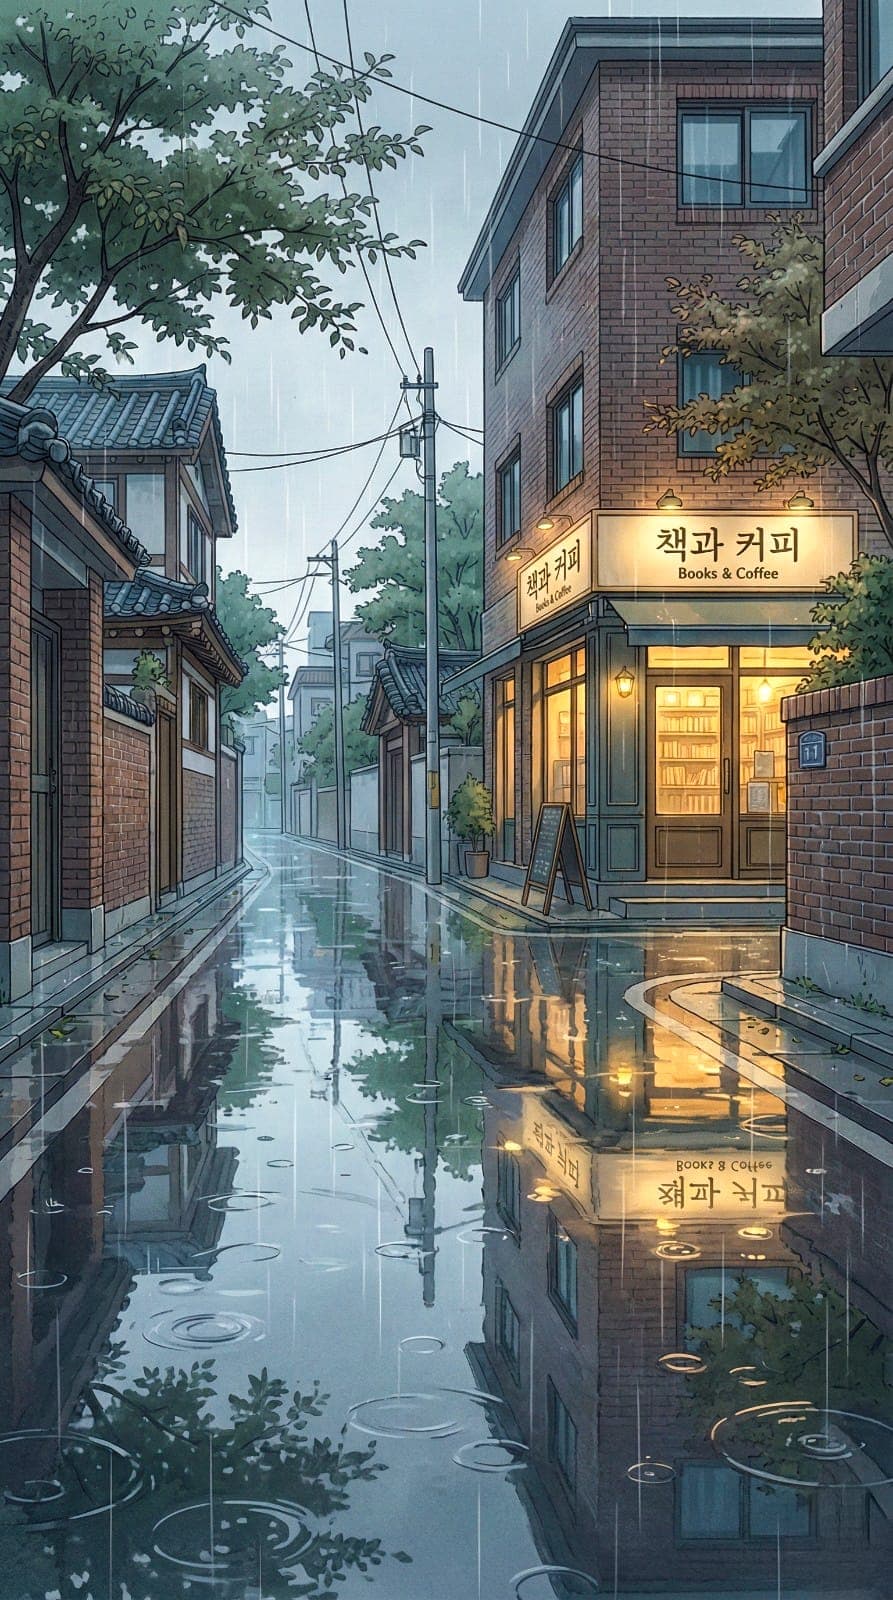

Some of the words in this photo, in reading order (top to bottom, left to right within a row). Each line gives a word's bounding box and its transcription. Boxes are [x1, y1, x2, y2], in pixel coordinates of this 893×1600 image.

[656, 526, 725, 563] 책과
[736, 526, 798, 563] 커피
[527, 561, 551, 600] 책과
[555, 538, 580, 581] 커피
[678, 567, 718, 579] Books
[722, 567, 732, 579] &
[736, 567, 779, 579] Coffee
[536, 598, 550, 613] Books
[554, 585, 572, 601] Coffee
